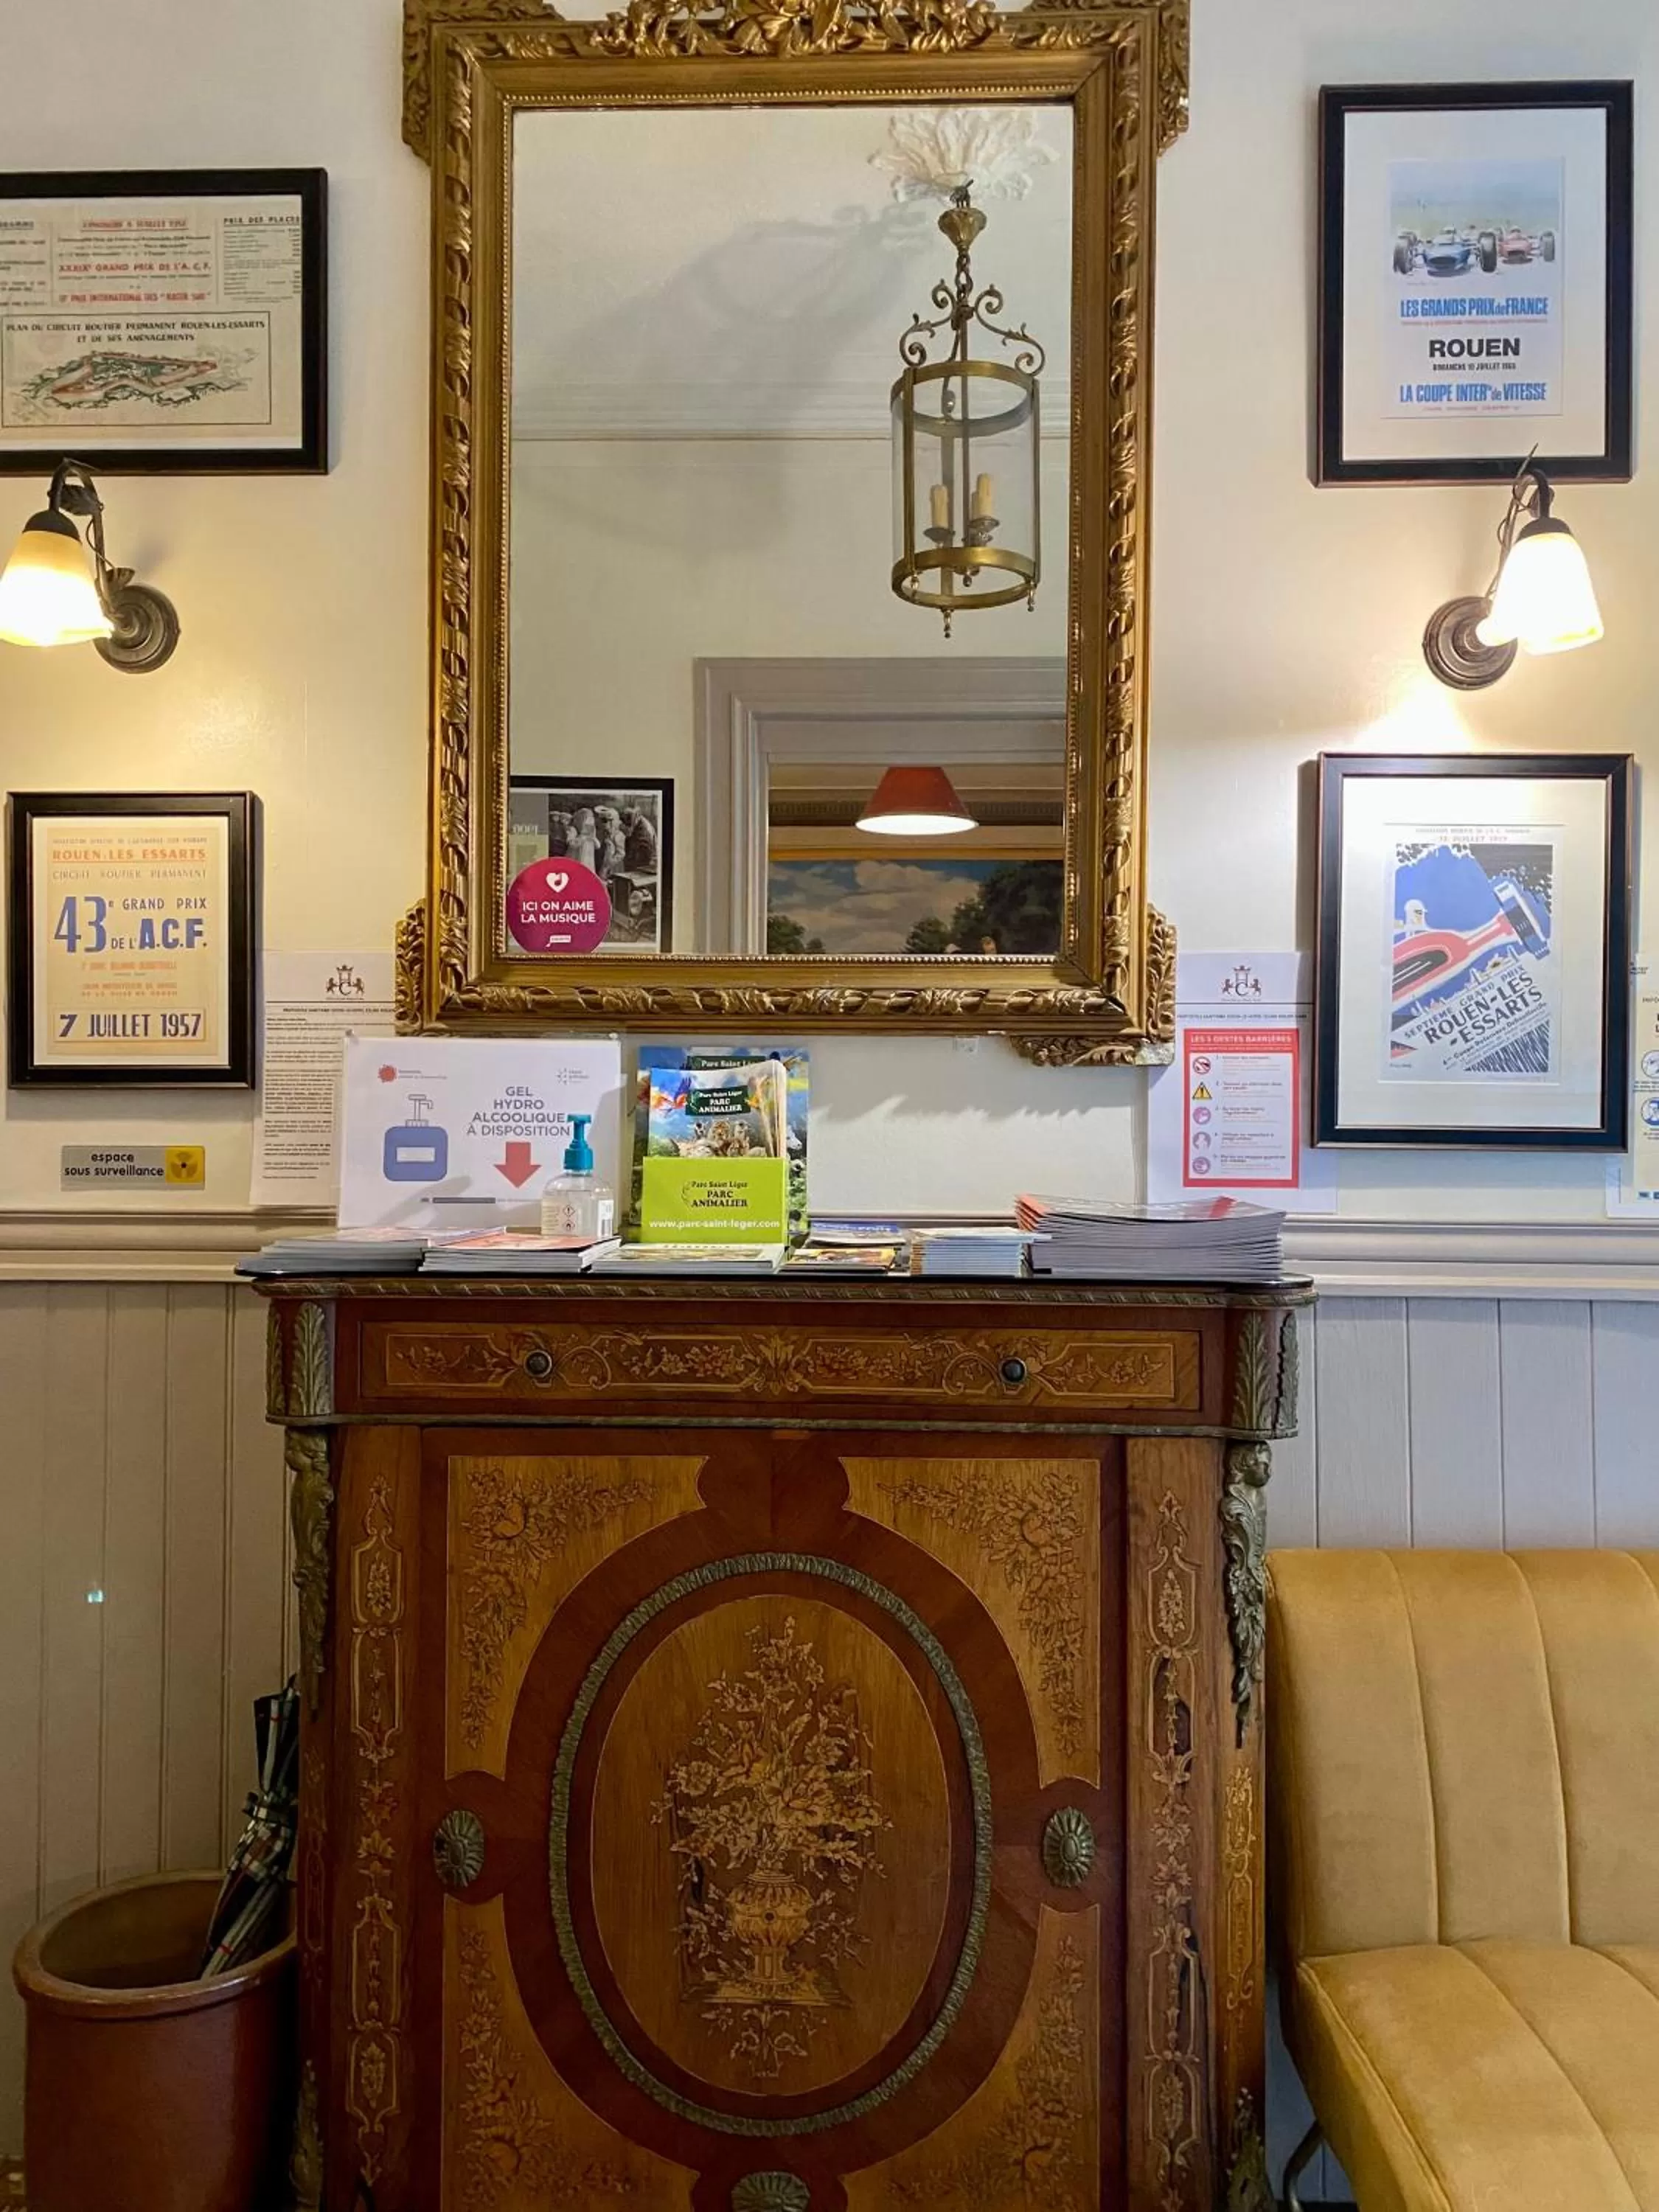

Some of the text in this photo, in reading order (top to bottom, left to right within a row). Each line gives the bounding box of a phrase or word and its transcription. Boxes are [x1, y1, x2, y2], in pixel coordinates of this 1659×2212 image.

[1400, 299, 1419, 318] LES
[1420, 298, 1467, 317] GRANDS
[1467, 297, 1495, 316] PRIX
[1506, 297, 1548, 315] FRANCE
[1428, 337, 1521, 358] ROUEN
[1400, 384, 1413, 403] LA
[1416, 383, 1453, 403] COUPE
[1503, 382, 1547, 400] VITESSE
[142, 848, 206, 860] ESSARTS
[52, 869, 206, 880] CIRCUIT ROUTIER PERMANENT
[122, 897, 165, 911] GRAND
[176, 897, 207, 910] PRIX
[523, 901, 594, 911] ICI ON AIME
[521, 914, 597, 924] LA MUSIQUE
[111, 937, 125, 950] DE
[1424, 971, 1533, 1045] ROUEN-LES
[58, 1013, 202, 1037] 7 JUILLET 1957
[505, 1086, 534, 1096] GEL
[493, 1099, 545, 1110] HYDRO
[698, 1105, 742, 1113] ANIMALIER
[472, 1113, 566, 1125] ALCOOLIQUE
[466, 1123, 571, 1136] À DISPOSITION
[91, 1152, 135, 1164] espace
[64, 1164, 164, 1177] sous surveillance
[707, 1190, 734, 1198] PARC
[692, 1199, 748, 1207] ANIMALIER
[649, 1219, 780, 1231] www.parc-saint-leger.com
